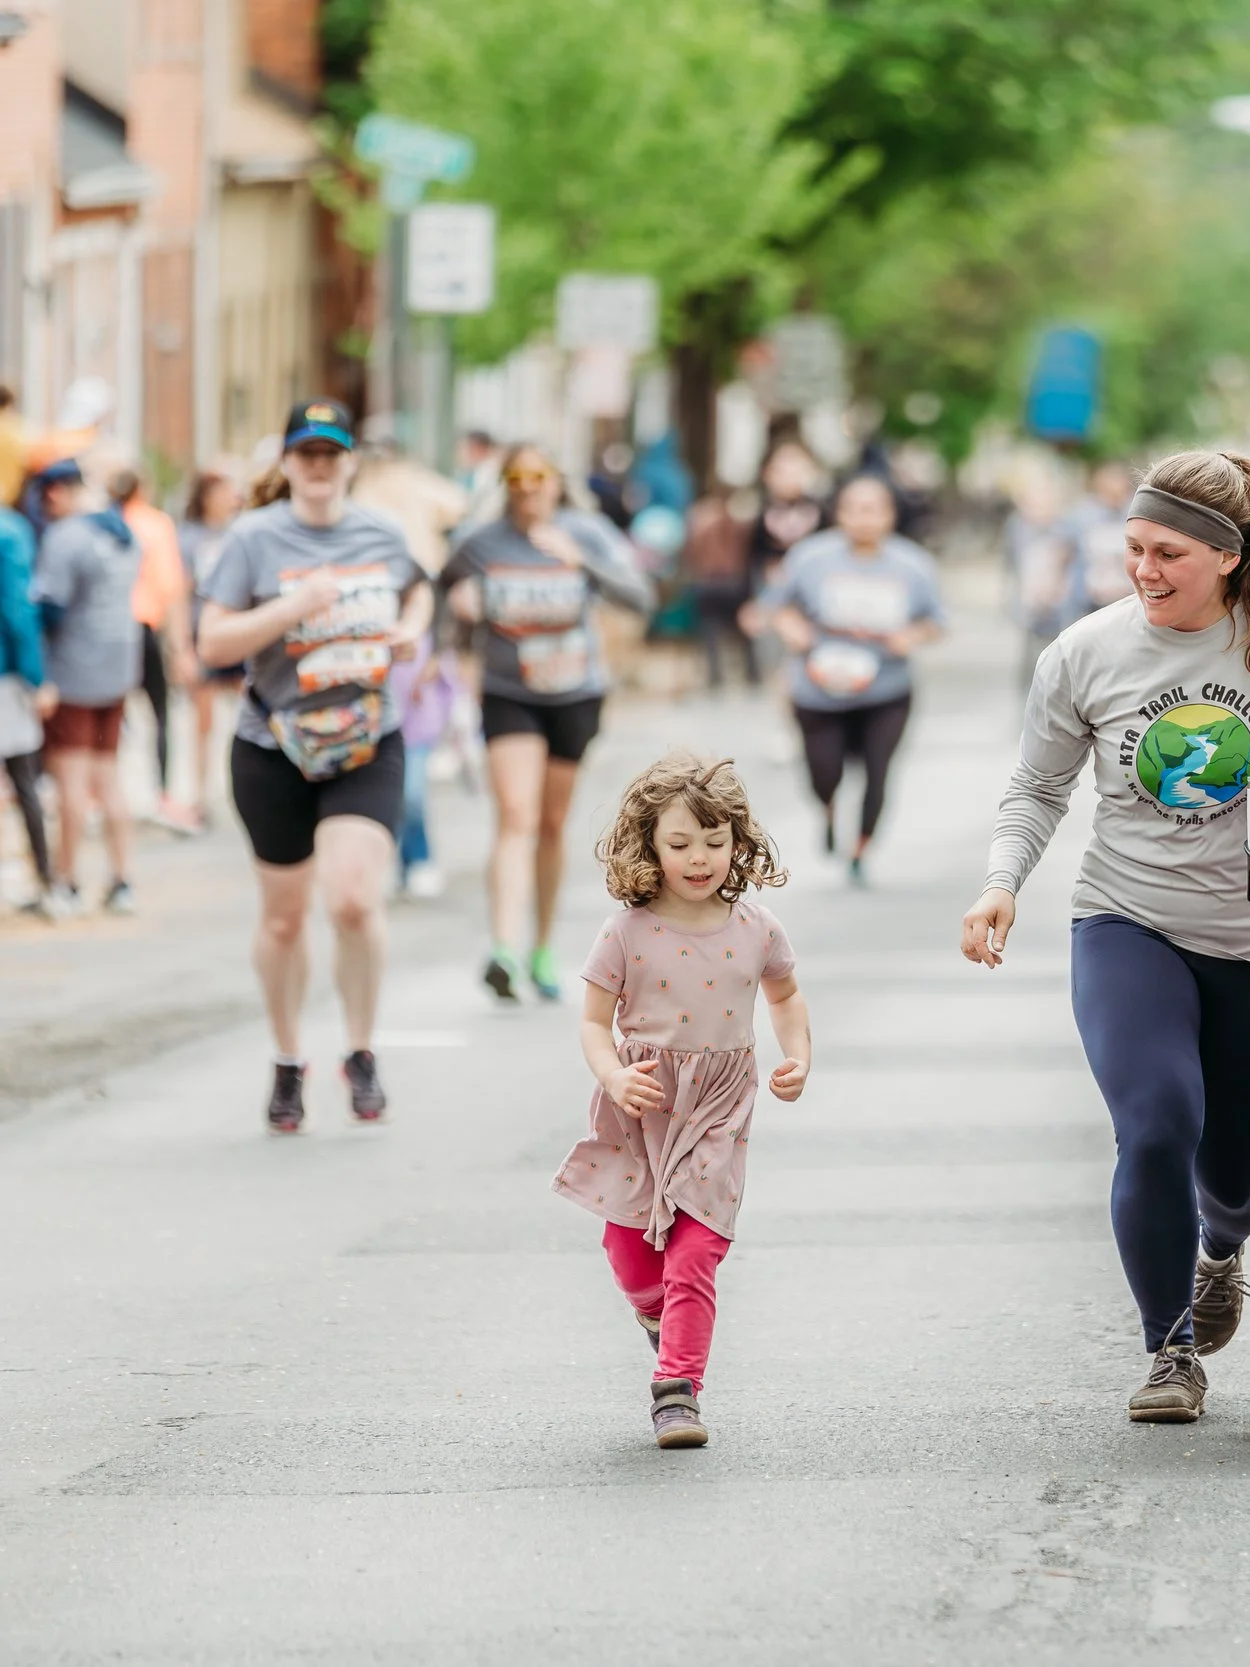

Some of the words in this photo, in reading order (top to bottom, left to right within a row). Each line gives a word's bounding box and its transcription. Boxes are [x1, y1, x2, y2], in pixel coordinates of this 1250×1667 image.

[1119, 728, 1140, 767] KTA
[1138, 686, 1189, 722] TRAIL
[1175, 814, 1204, 825] Trails
[1210, 793, 1247, 821] Associa
